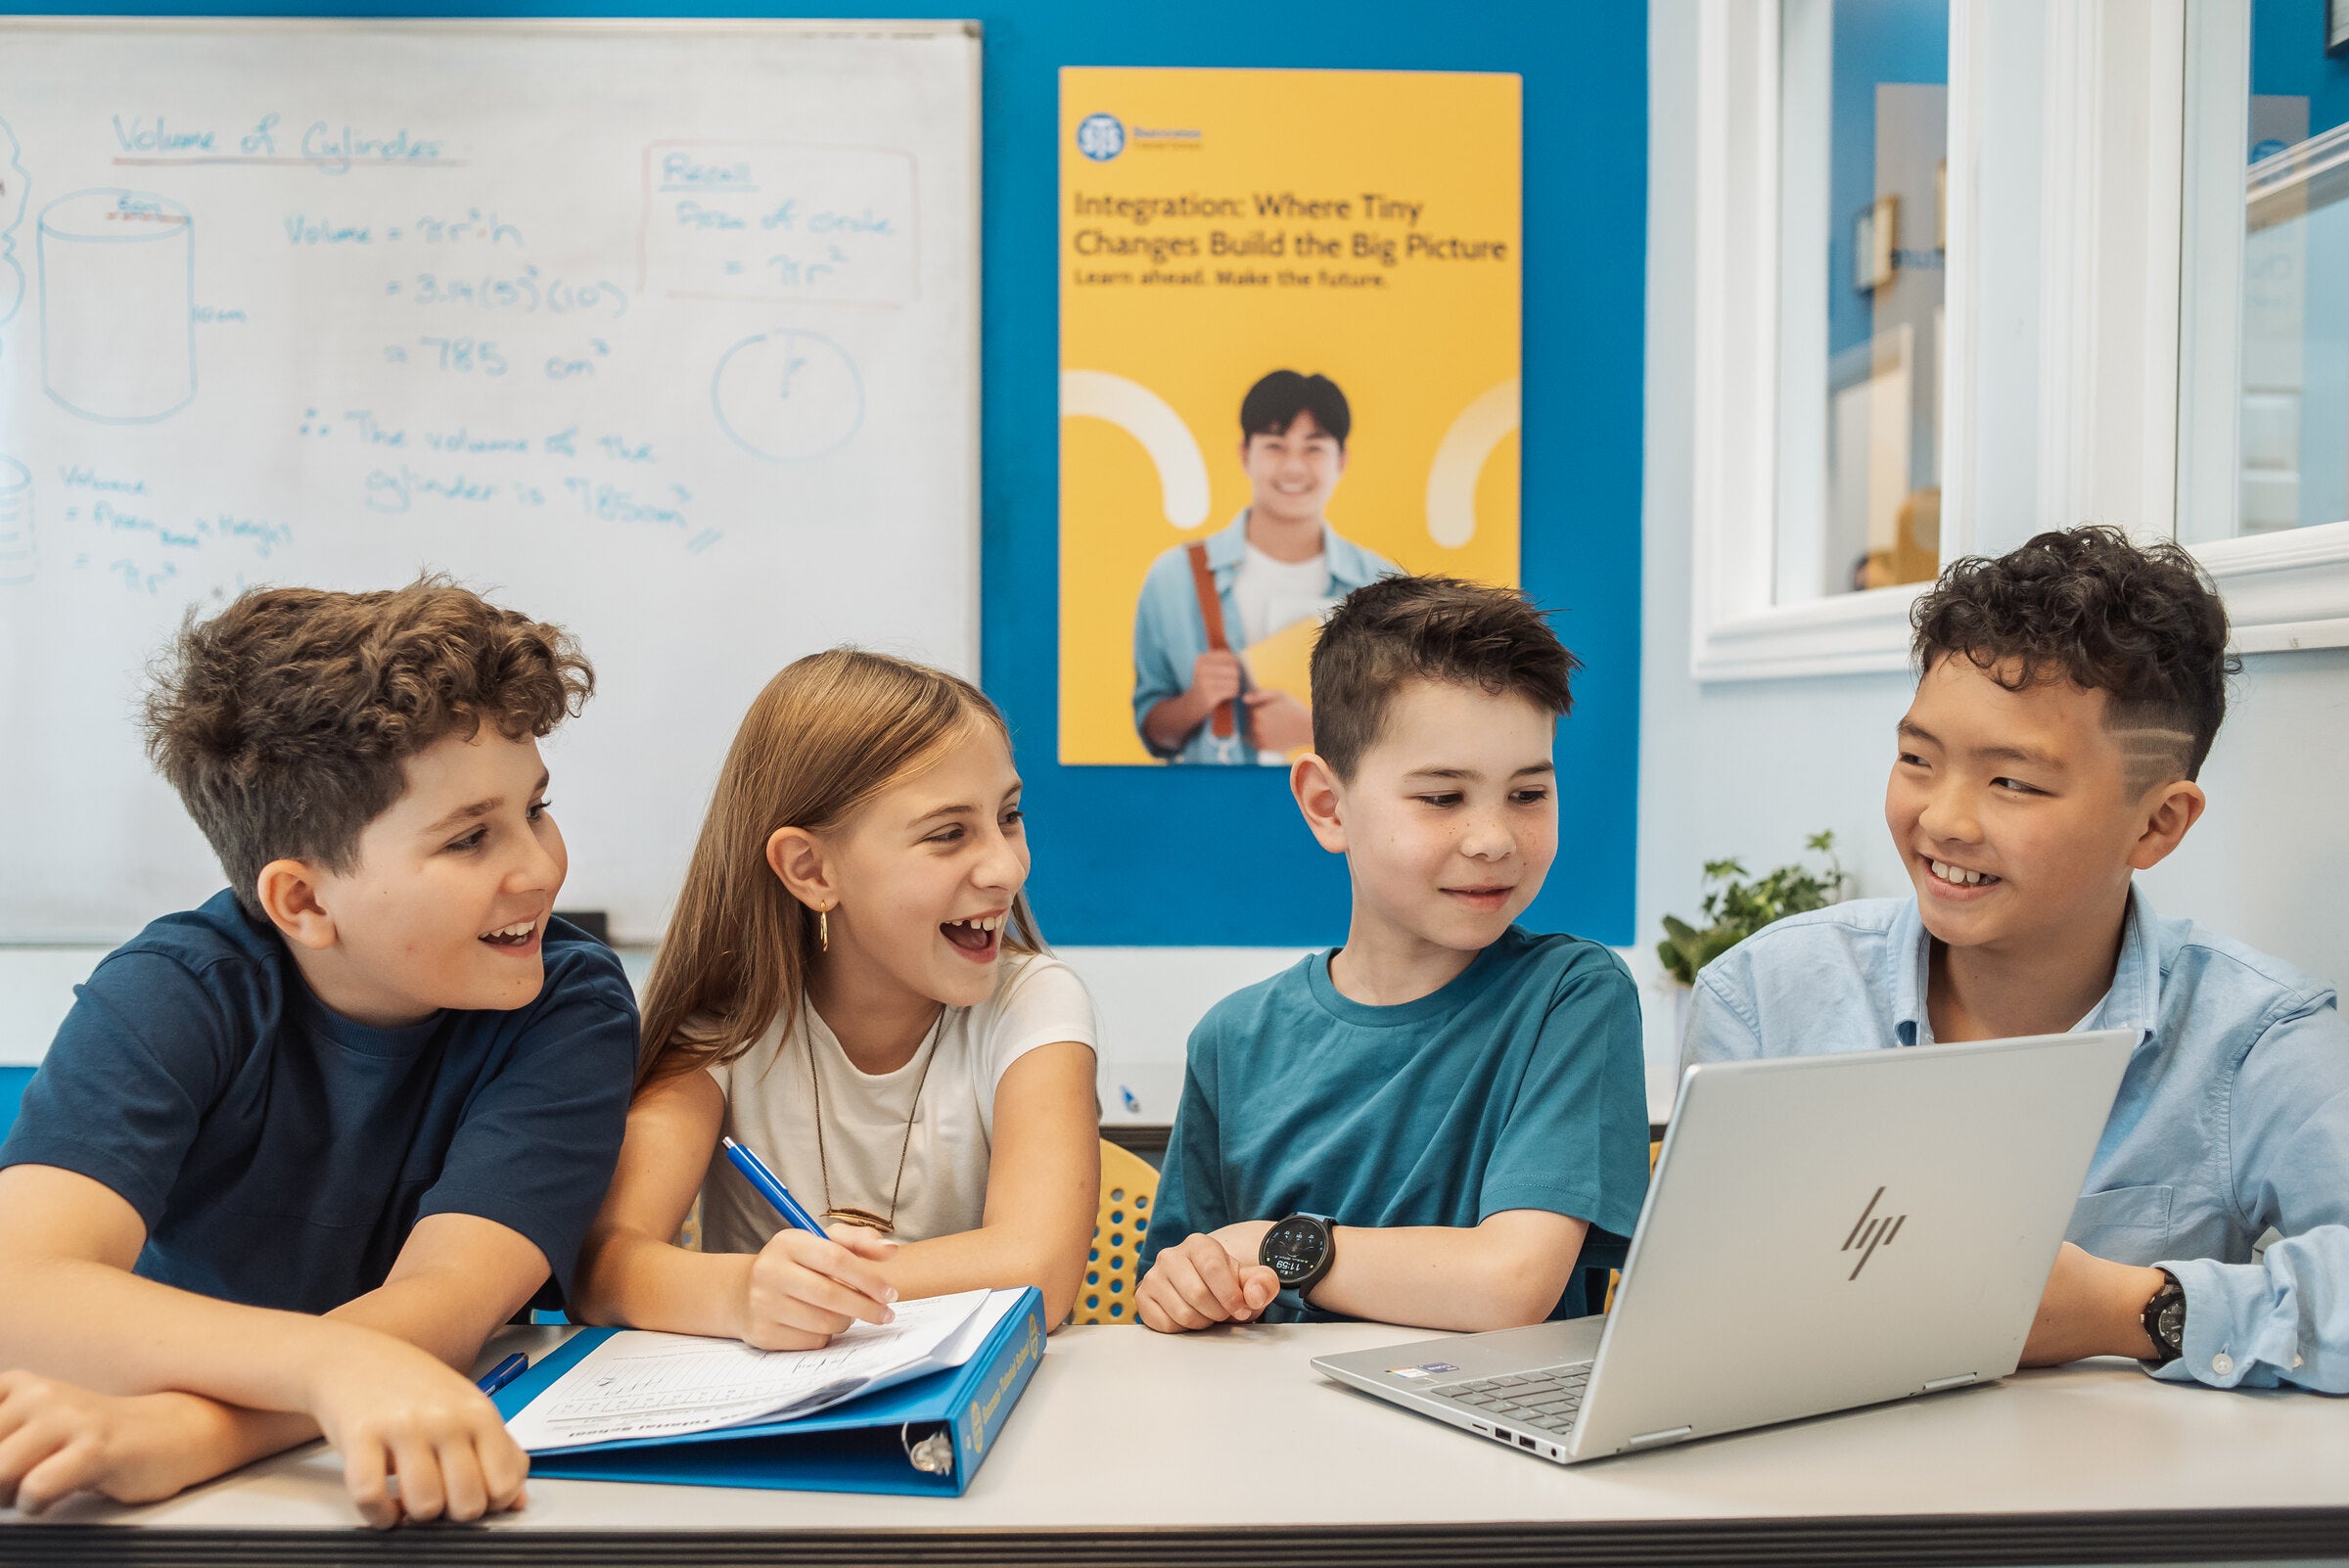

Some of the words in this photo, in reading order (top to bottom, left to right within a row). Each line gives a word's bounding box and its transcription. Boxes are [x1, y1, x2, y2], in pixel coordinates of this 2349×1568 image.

[113, 114, 218, 152] Volume
[241, 113, 280, 155] of
[301, 121, 443, 175] Cylinder
[1074, 192, 1242, 225] Integration:
[1252, 193, 1352, 218] Where
[1361, 193, 1423, 226] Tiny
[285, 214, 370, 244] Volume
[1075, 230, 1198, 265] Changes
[1210, 232, 1284, 256] Build
[1295, 233, 1342, 257] the
[1353, 233, 1397, 266] Big
[1405, 235, 1507, 261] Picture
[1217, 269, 1269, 286] Make
[1277, 270, 1312, 287] the
[418, 337, 508, 377] 785
[1276, 1260, 1301, 1271] 11:59
